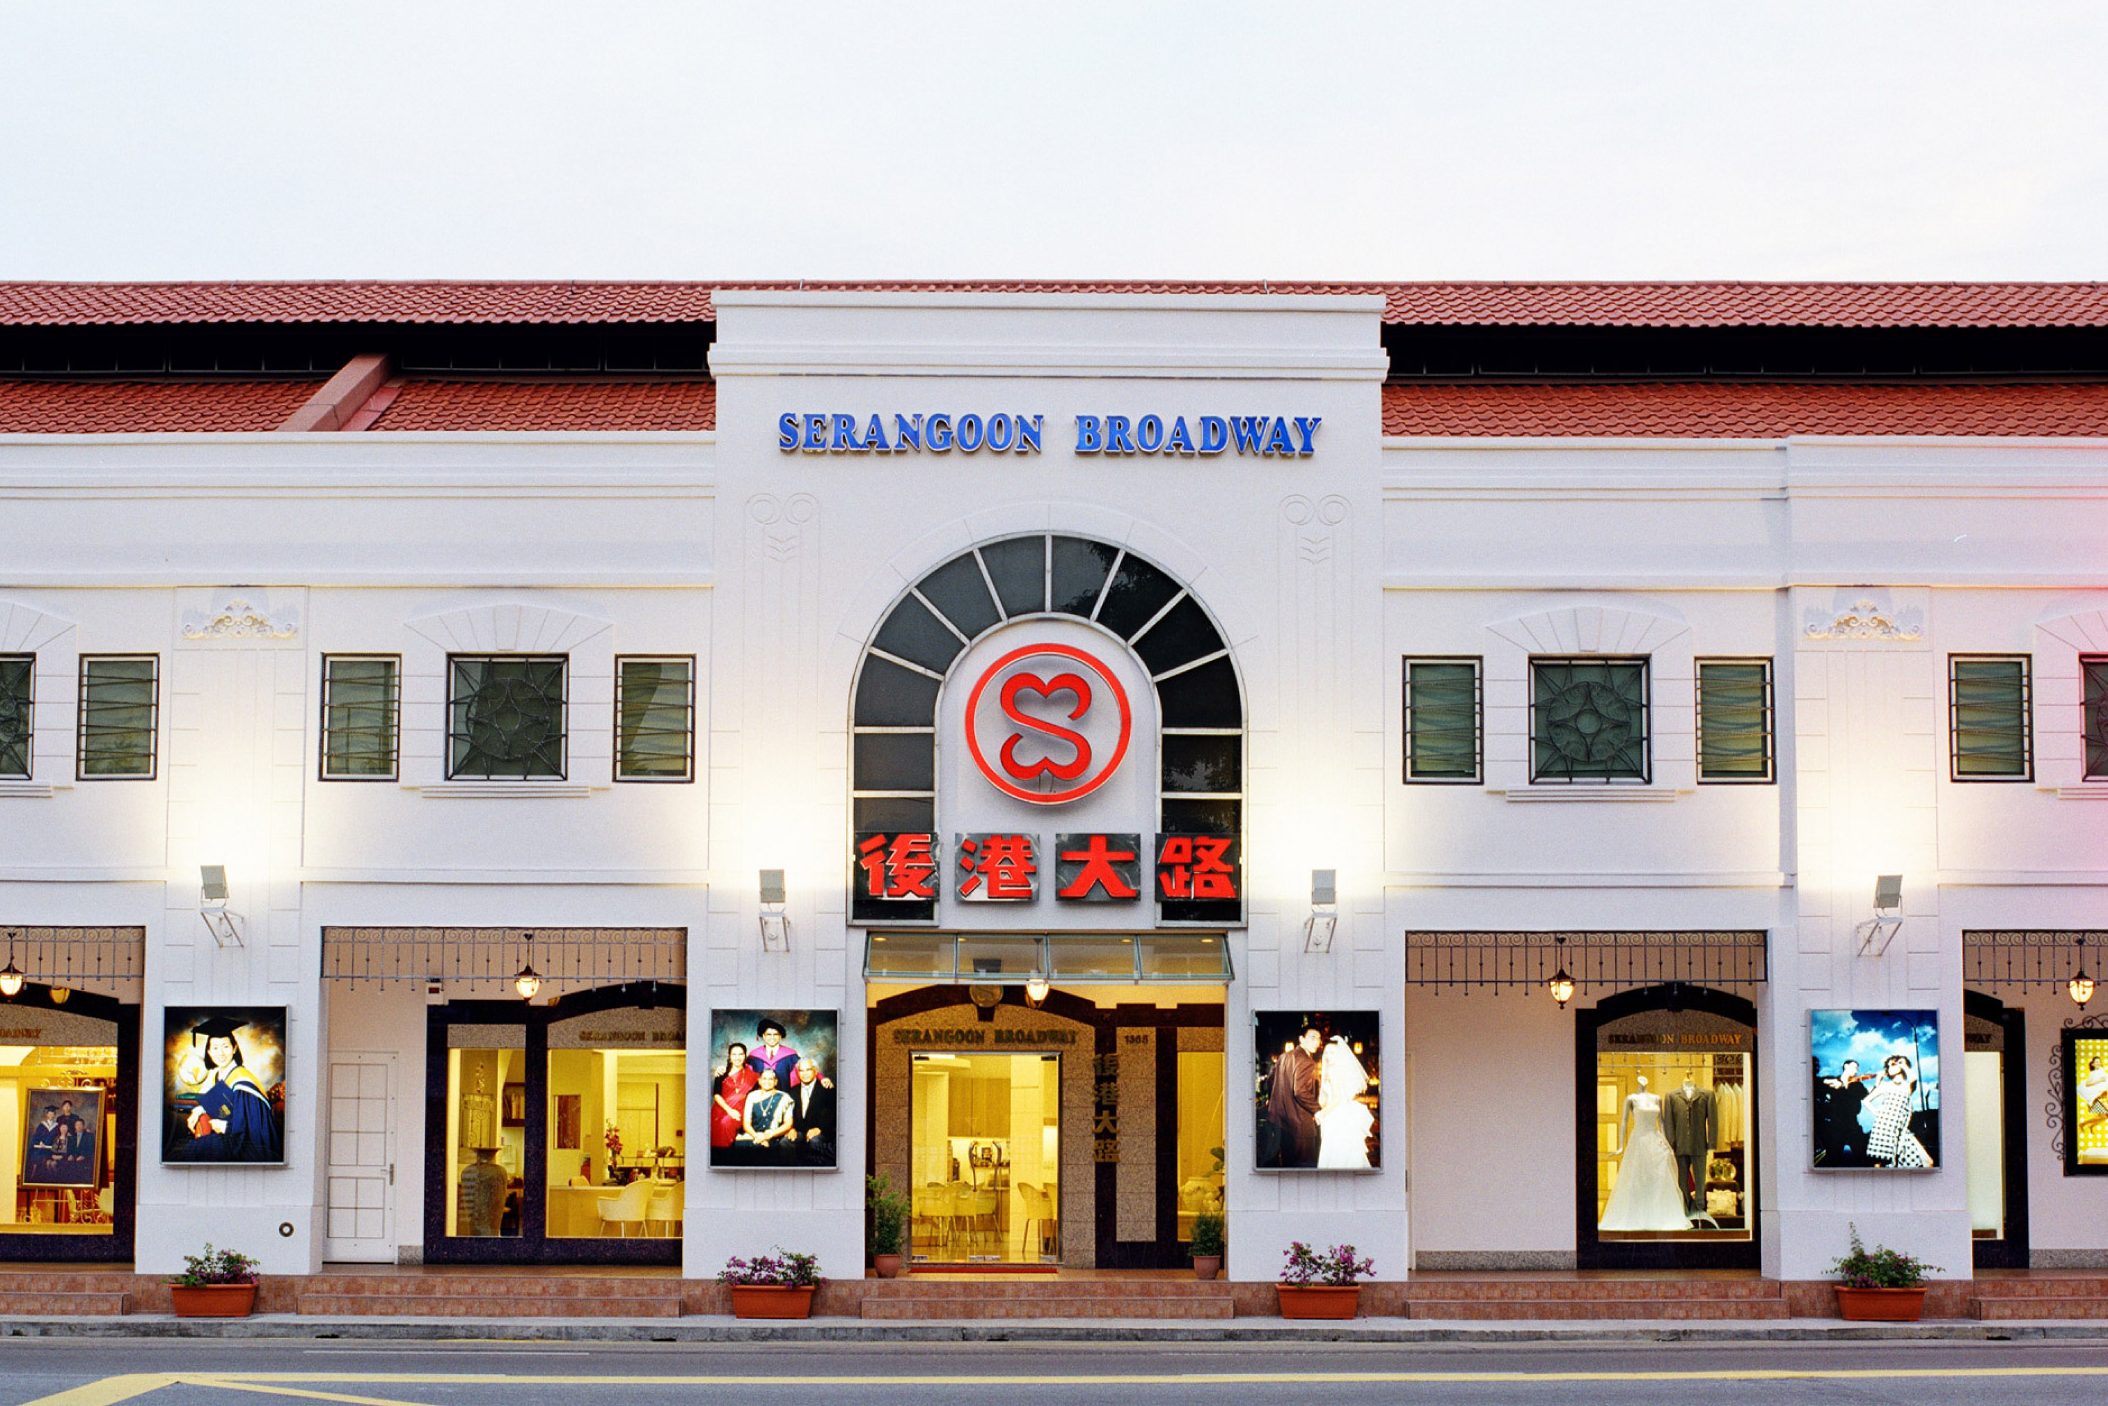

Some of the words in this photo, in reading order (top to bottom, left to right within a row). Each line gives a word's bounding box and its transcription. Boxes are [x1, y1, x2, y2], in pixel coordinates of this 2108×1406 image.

[778, 412, 1044, 454] SERANGOON
[1074, 414, 1323, 456] BROADWAY
[859, 833, 1236, 899] 後港大路
[893, 1028, 986, 1045] SERANGOON
[994, 1028, 1077, 1045] BROADWAY
[1679, 1033, 1742, 1045] BROADWAY
